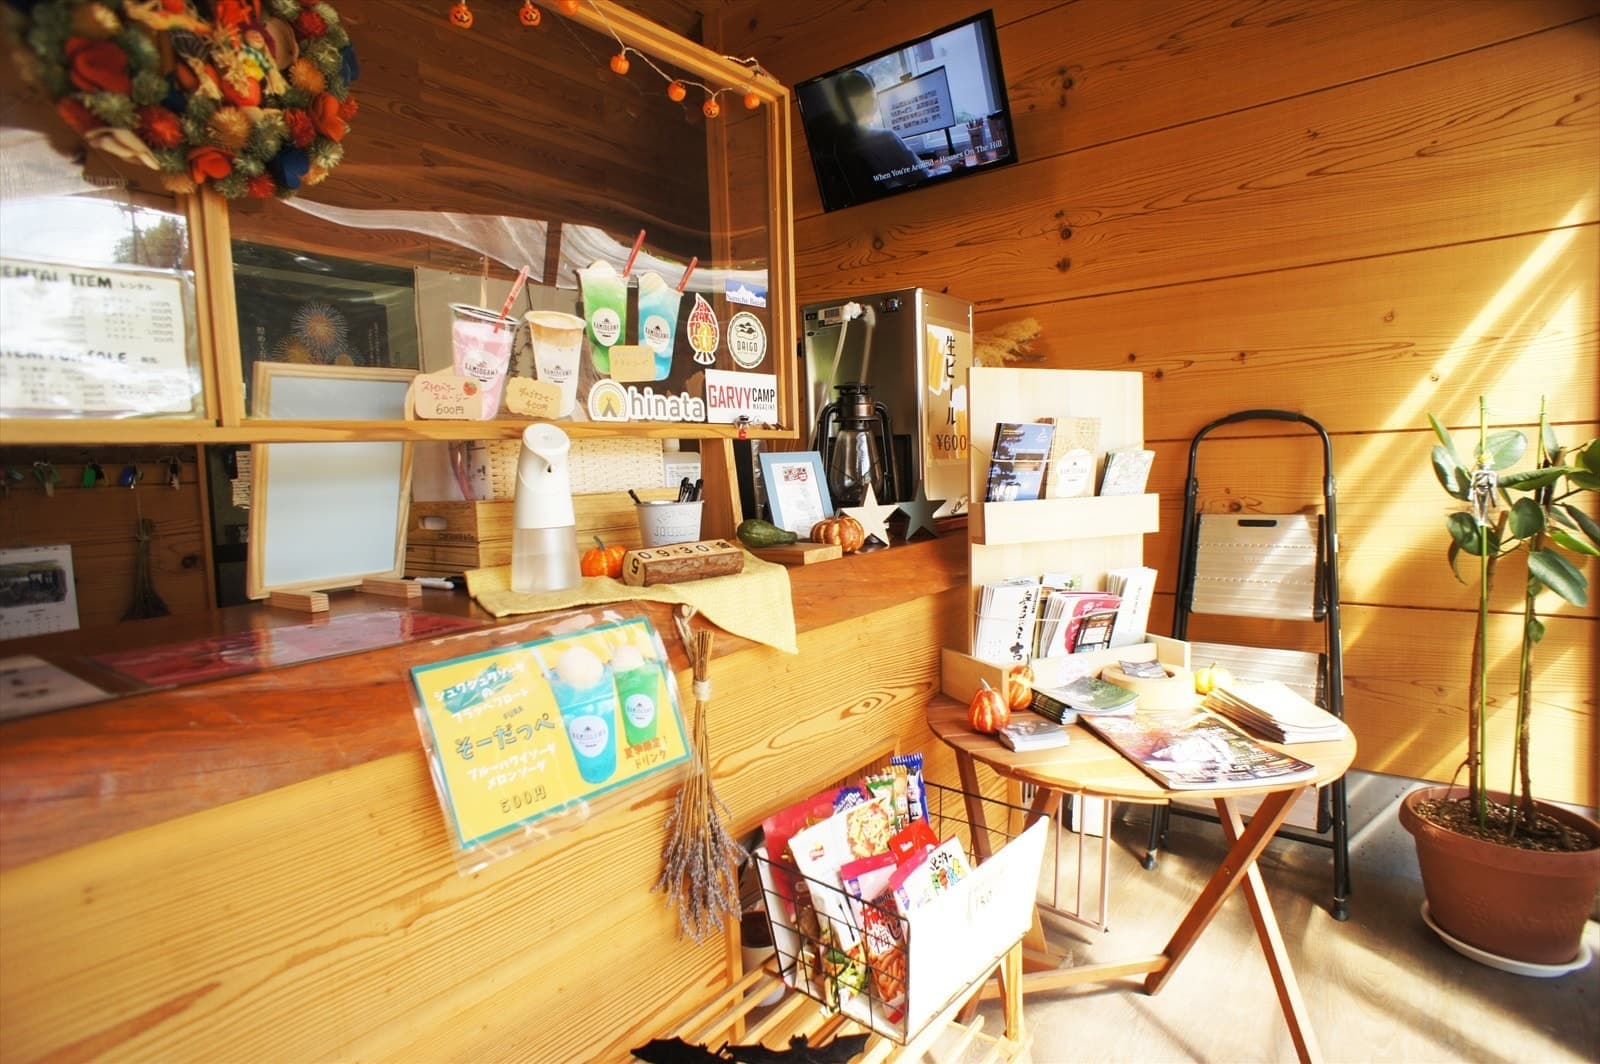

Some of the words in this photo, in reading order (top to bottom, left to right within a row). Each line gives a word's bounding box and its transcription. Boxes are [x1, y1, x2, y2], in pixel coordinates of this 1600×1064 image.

[872, 172, 891, 182] When
[891, 167, 911, 178] You're
[911, 160, 934, 173] Around
[939, 152, 964, 164] Houses
[975, 144, 989, 154] The
[990, 139, 1003, 150] Hill
[0, 264, 58, 282] ENTAL
[70, 273, 113, 290] ITEM
[945, 335, 957, 425] 生ビール
[436, 403, 464, 415] 600円
[630, 389, 704, 419] hinata
[708, 385, 752, 410] GARVY
[752, 387, 776, 402] CAMP
[936, 434, 967, 452] ¥600
[455, 713, 556, 760] そーだっぺ
[635, 750, 667, 769] ドリンク
[500, 785, 547, 814] 500円
